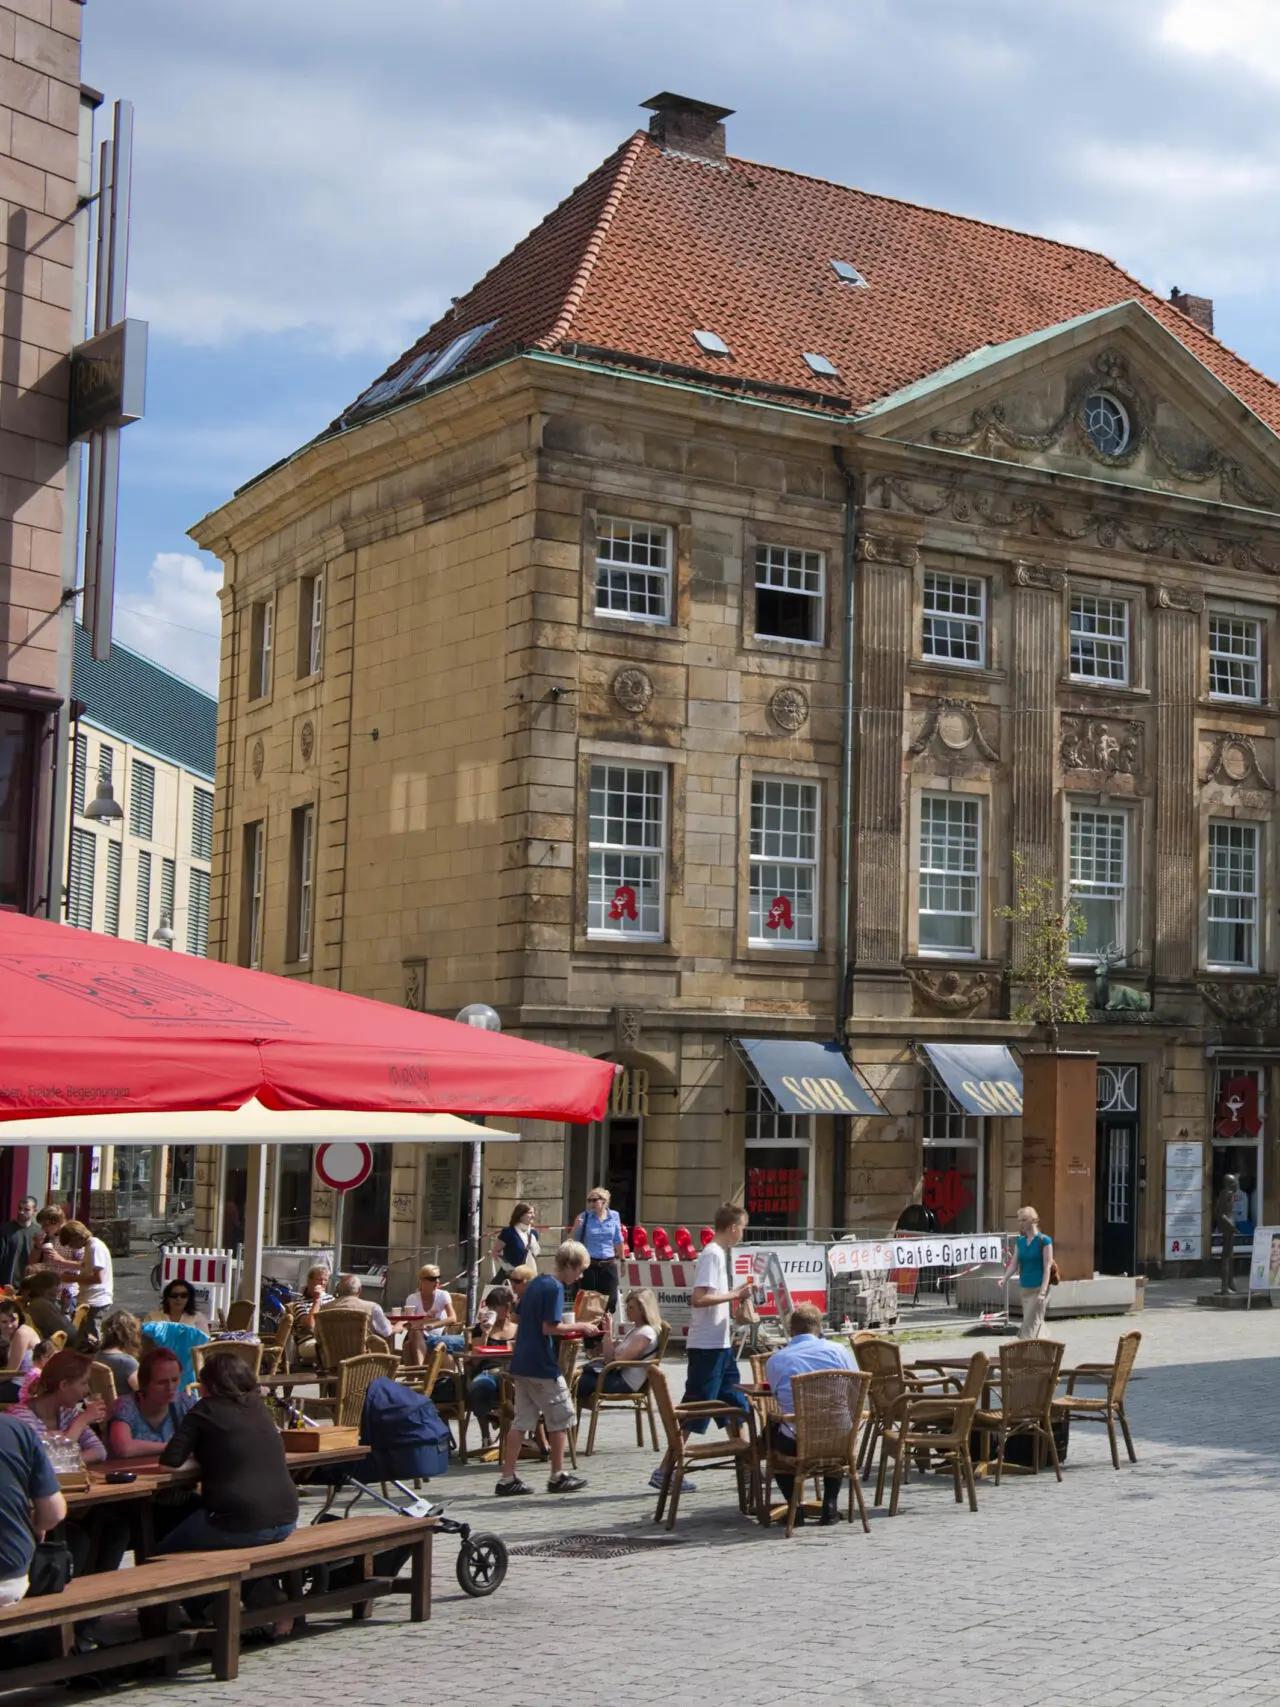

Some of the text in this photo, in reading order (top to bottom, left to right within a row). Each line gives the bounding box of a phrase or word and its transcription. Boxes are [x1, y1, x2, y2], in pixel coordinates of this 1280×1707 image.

[612, 1069, 651, 1117] ØR
[782, 1075, 859, 1112] SØR
[896, 1244, 998, 1265] Café-Garten
[782, 1260, 823, 1274] TFELD
[658, 1291, 692, 1306] Hennig
